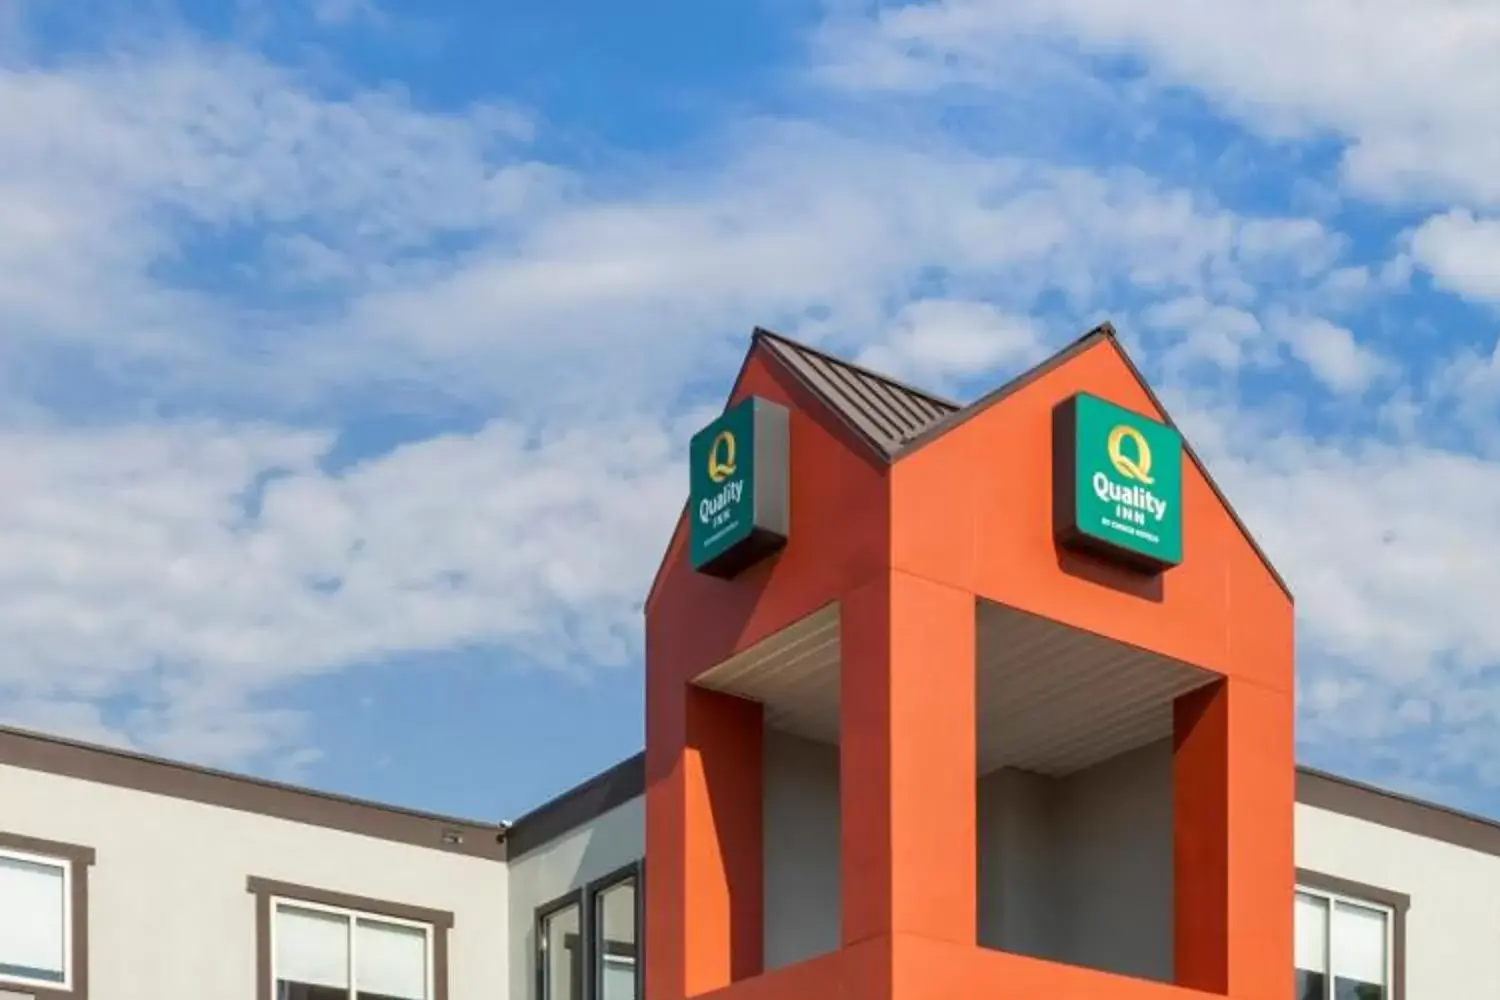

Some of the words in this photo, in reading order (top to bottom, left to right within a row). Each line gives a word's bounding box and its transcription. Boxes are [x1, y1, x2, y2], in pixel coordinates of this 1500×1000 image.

[708, 431, 736, 482] Q
[1108, 425, 1154, 484] Q
[700, 479, 744, 524] Quality
[1092, 472, 1167, 520] Quality
[1115, 504, 1145, 526] INN
